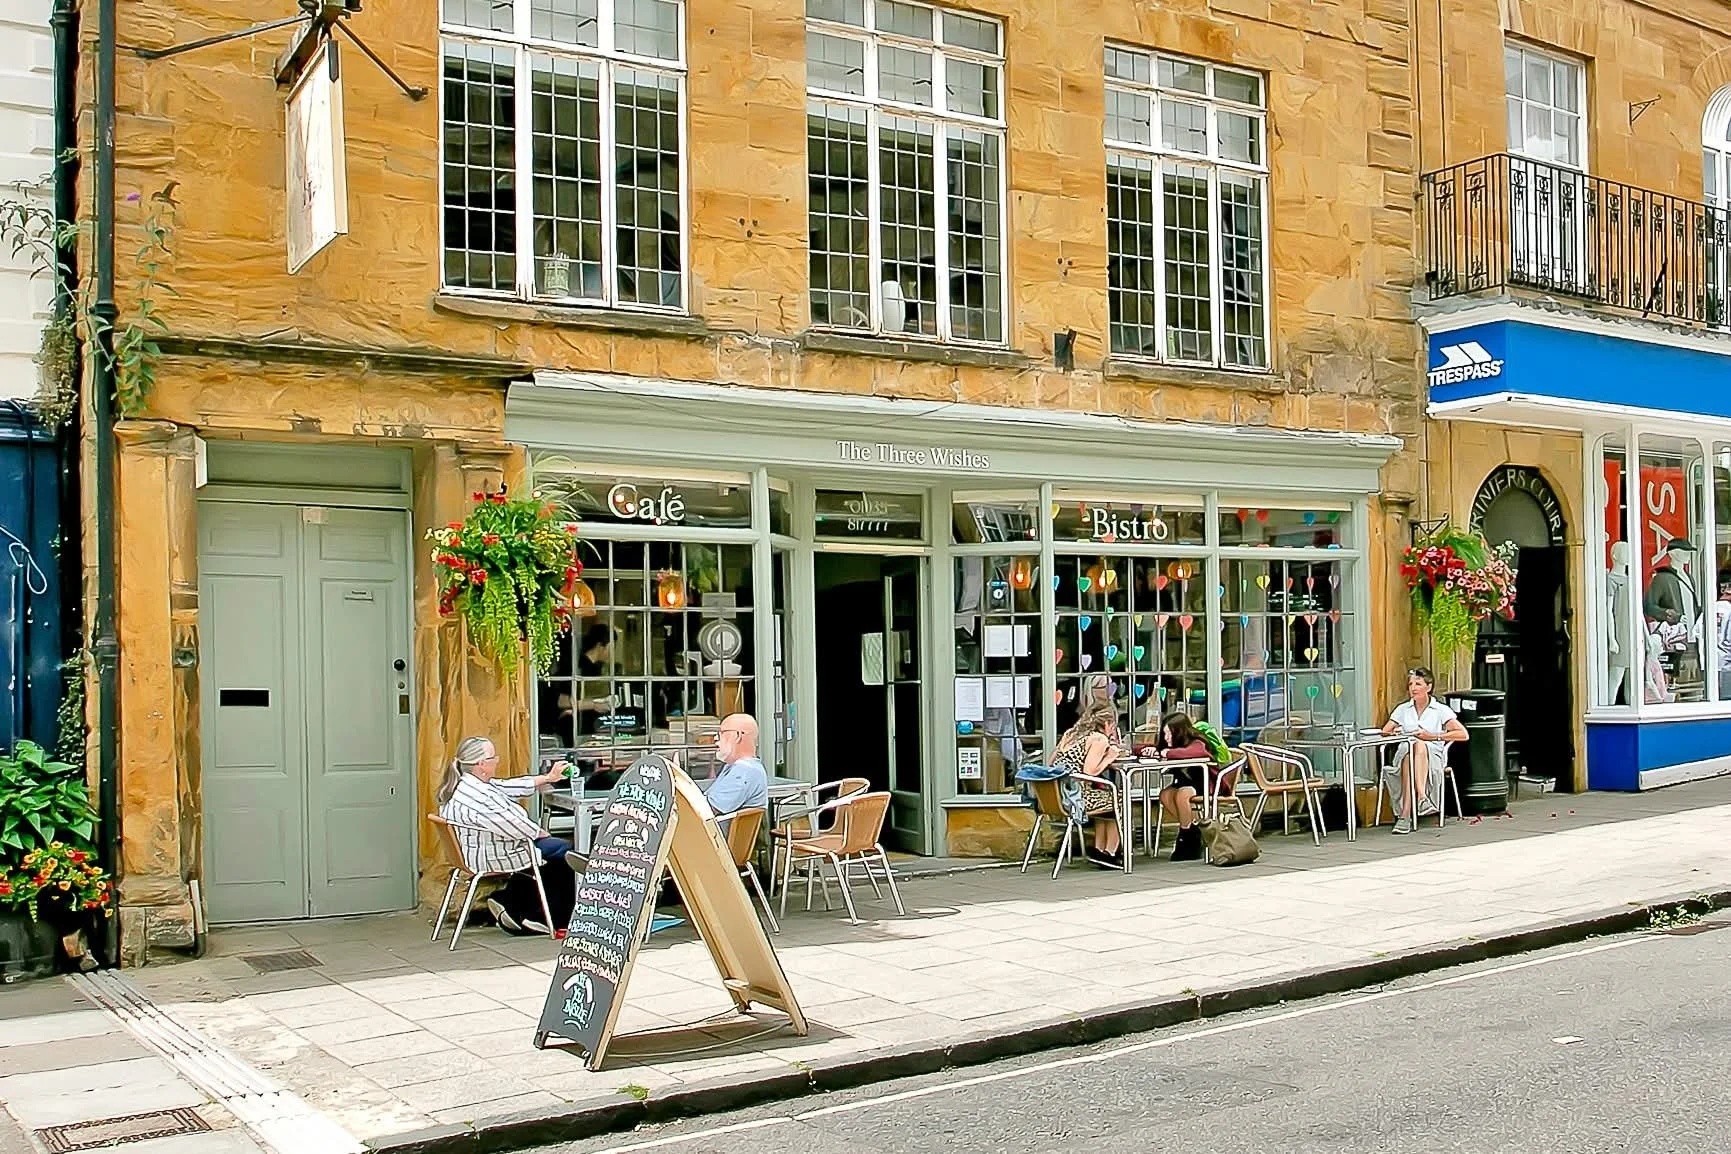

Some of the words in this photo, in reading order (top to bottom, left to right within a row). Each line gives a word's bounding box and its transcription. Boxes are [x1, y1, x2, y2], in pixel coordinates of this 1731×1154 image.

[1427, 360, 1502, 387] TRESPASS
[836, 440, 871, 460] The
[876, 443, 925, 465] Three
[931, 447, 990, 468] Wishes
[607, 483, 685, 521] Café
[1092, 508, 1168, 540] Bistro
